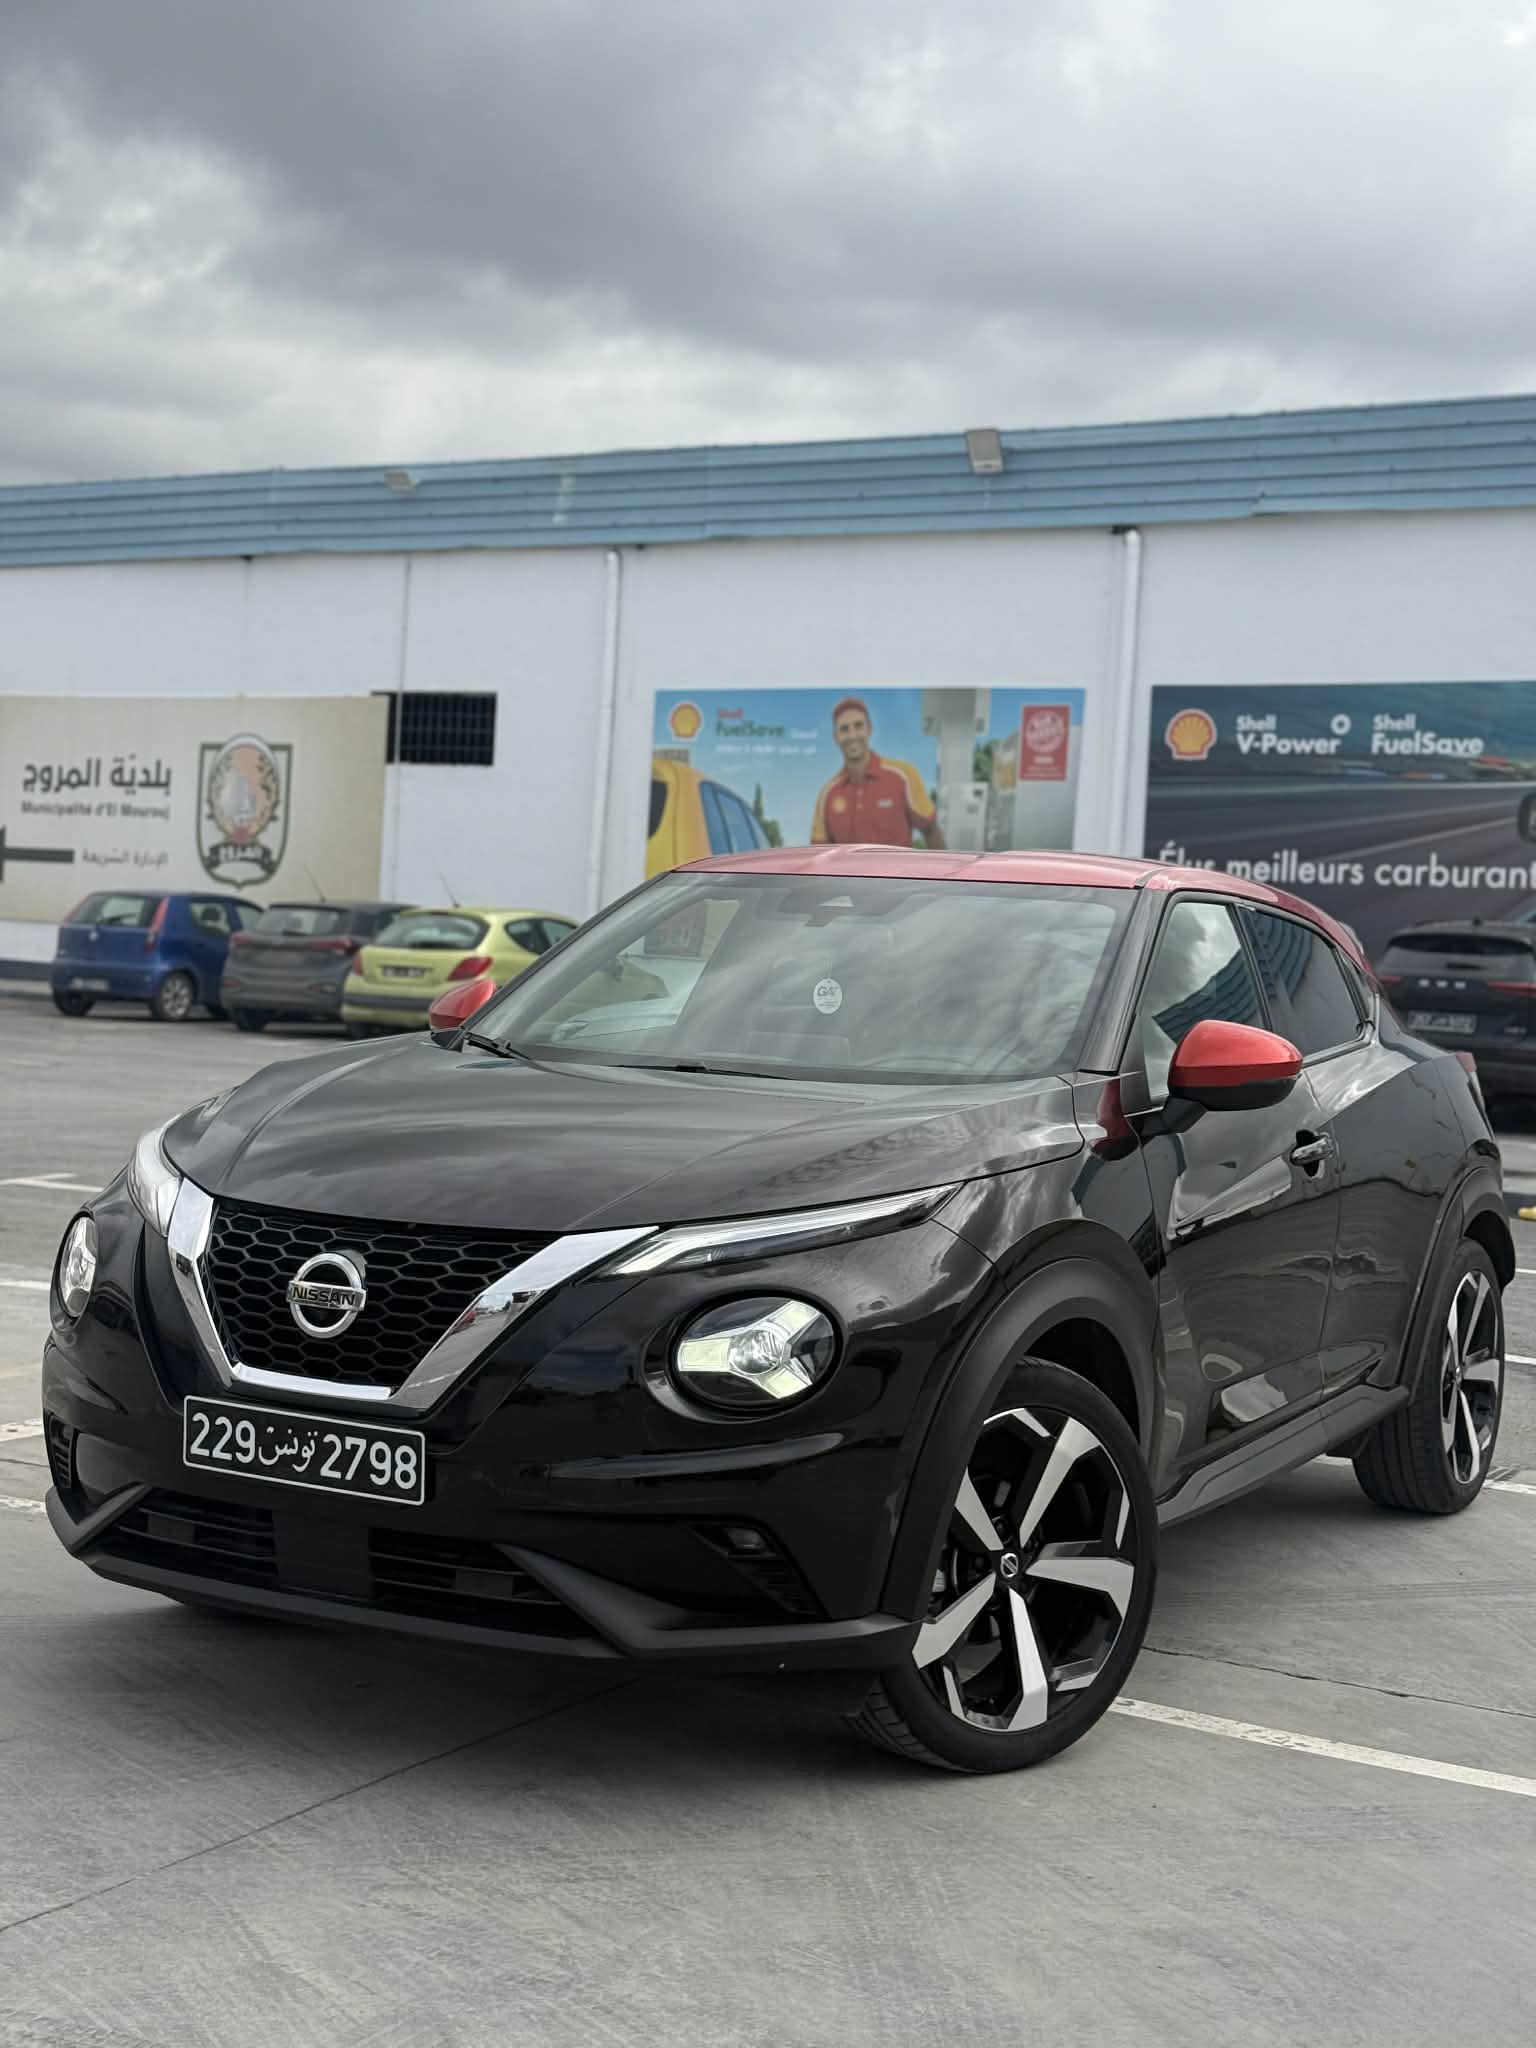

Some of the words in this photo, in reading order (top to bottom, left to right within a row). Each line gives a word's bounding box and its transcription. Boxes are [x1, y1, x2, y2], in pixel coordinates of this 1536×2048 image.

[1236, 714, 1277, 731] Shell
[1373, 713, 1416, 731] Shell
[1236, 733, 1341, 755] V-Power
[1371, 730, 1485, 759] FuelSave
[22, 757, 102, 795] المروج
[1226, 848, 1365, 885] meilleurs
[292, 1286, 356, 1306] NISSAN
[190, 1412, 256, 1464] 229
[258, 1426, 318, 1473] تونس
[320, 1433, 418, 1490] 2798
